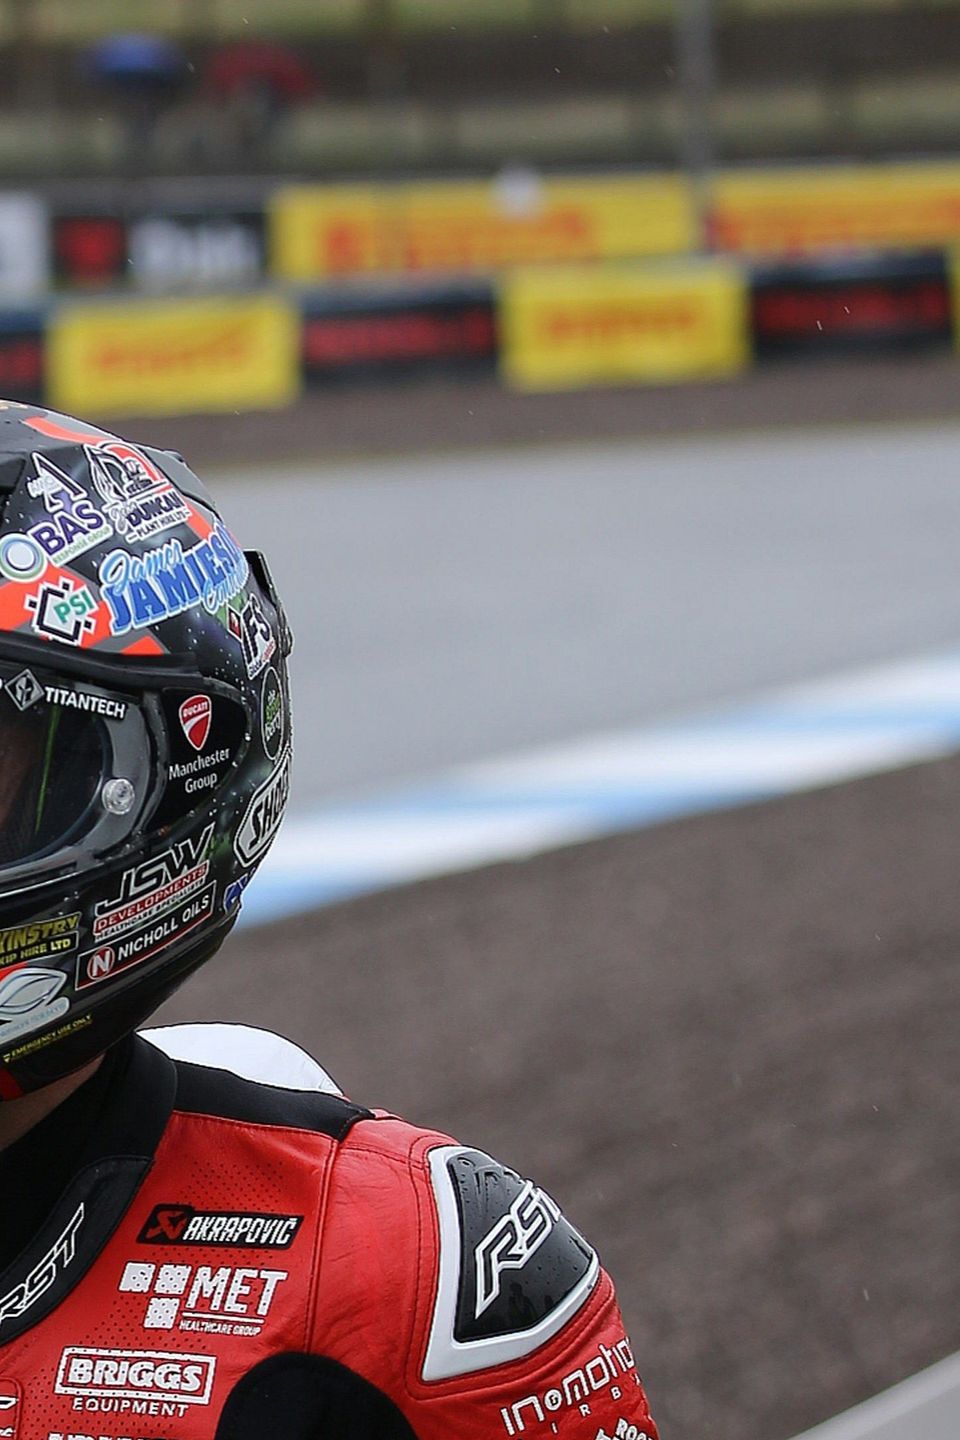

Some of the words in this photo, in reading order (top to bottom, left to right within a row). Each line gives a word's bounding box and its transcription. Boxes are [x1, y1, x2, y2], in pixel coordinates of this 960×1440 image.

[31, 503, 104, 556] BAS
[53, 589, 95, 624] PSI
[44, 686, 127, 719] TITANTECH
[182, 701, 209, 718] DUCATI
[168, 747, 230, 781] Manchester
[184, 772, 218, 795] Group
[97, 864, 206, 930] DEVELOPMENTS
[118, 917, 179, 961] NICHOLL
[182, 894, 210, 923] OILS
[20, 943, 48, 958] HIRE
[50, 938, 71, 951] LTD
[185, 1265, 288, 1316] MET
[232, 1325, 262, 1336] GROUP
[67, 1358, 204, 1391] BRIGGS
[72, 1397, 189, 1418] EQUIPMENT
